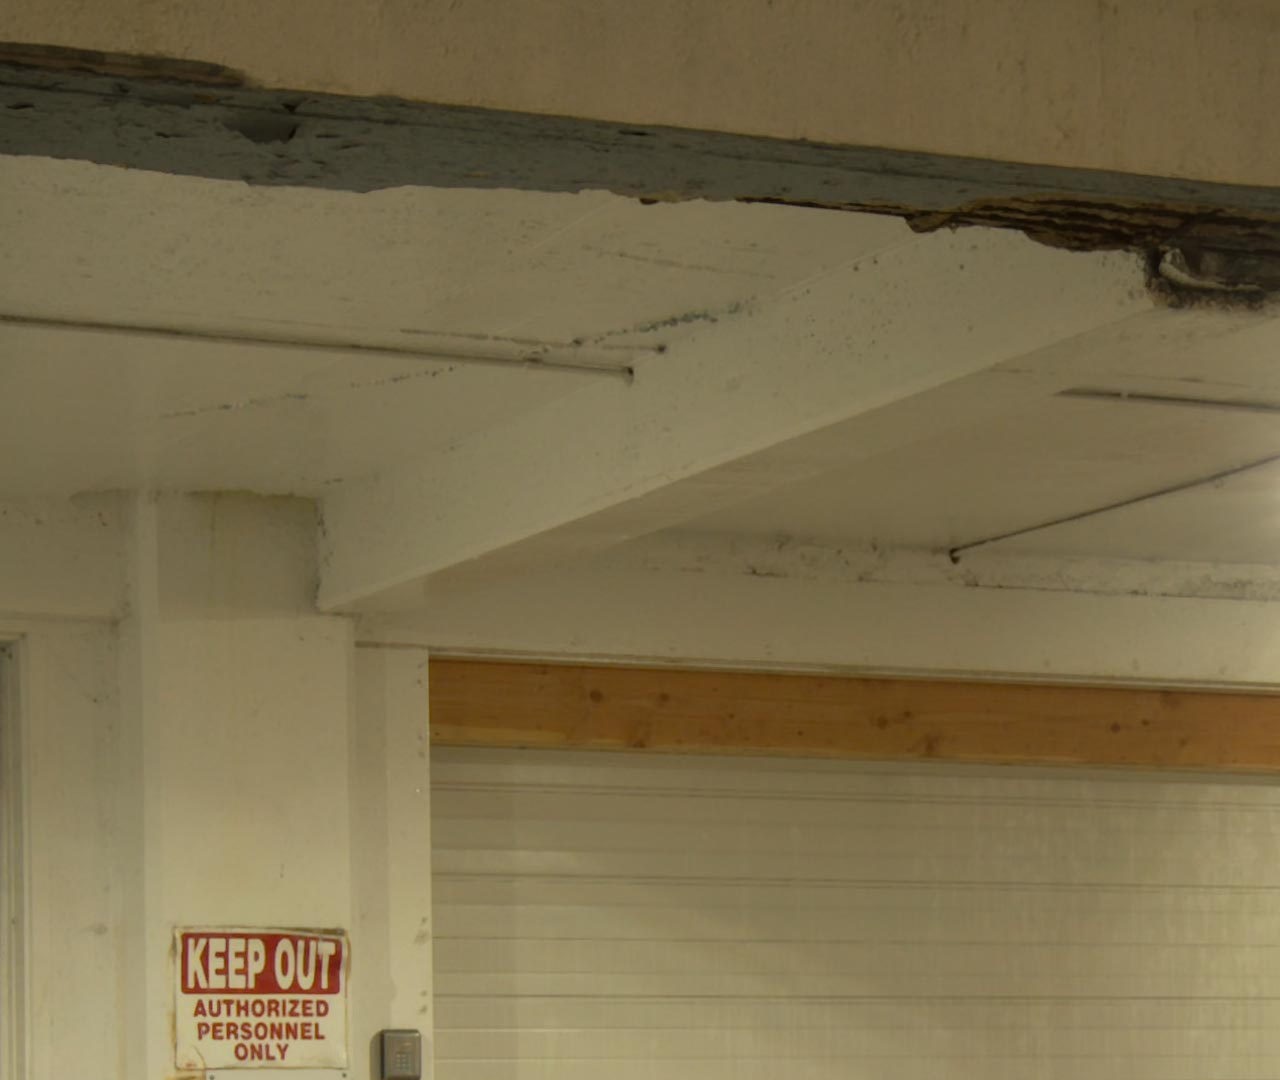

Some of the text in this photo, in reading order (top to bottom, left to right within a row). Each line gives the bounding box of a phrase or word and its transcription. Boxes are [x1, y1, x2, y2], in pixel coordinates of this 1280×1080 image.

[187, 938, 336, 991] KEEP OUT
[193, 999, 329, 1018] AUTHORIZED
[197, 1022, 325, 1040] PERSONNEL
[234, 1044, 289, 1061] ONLY
